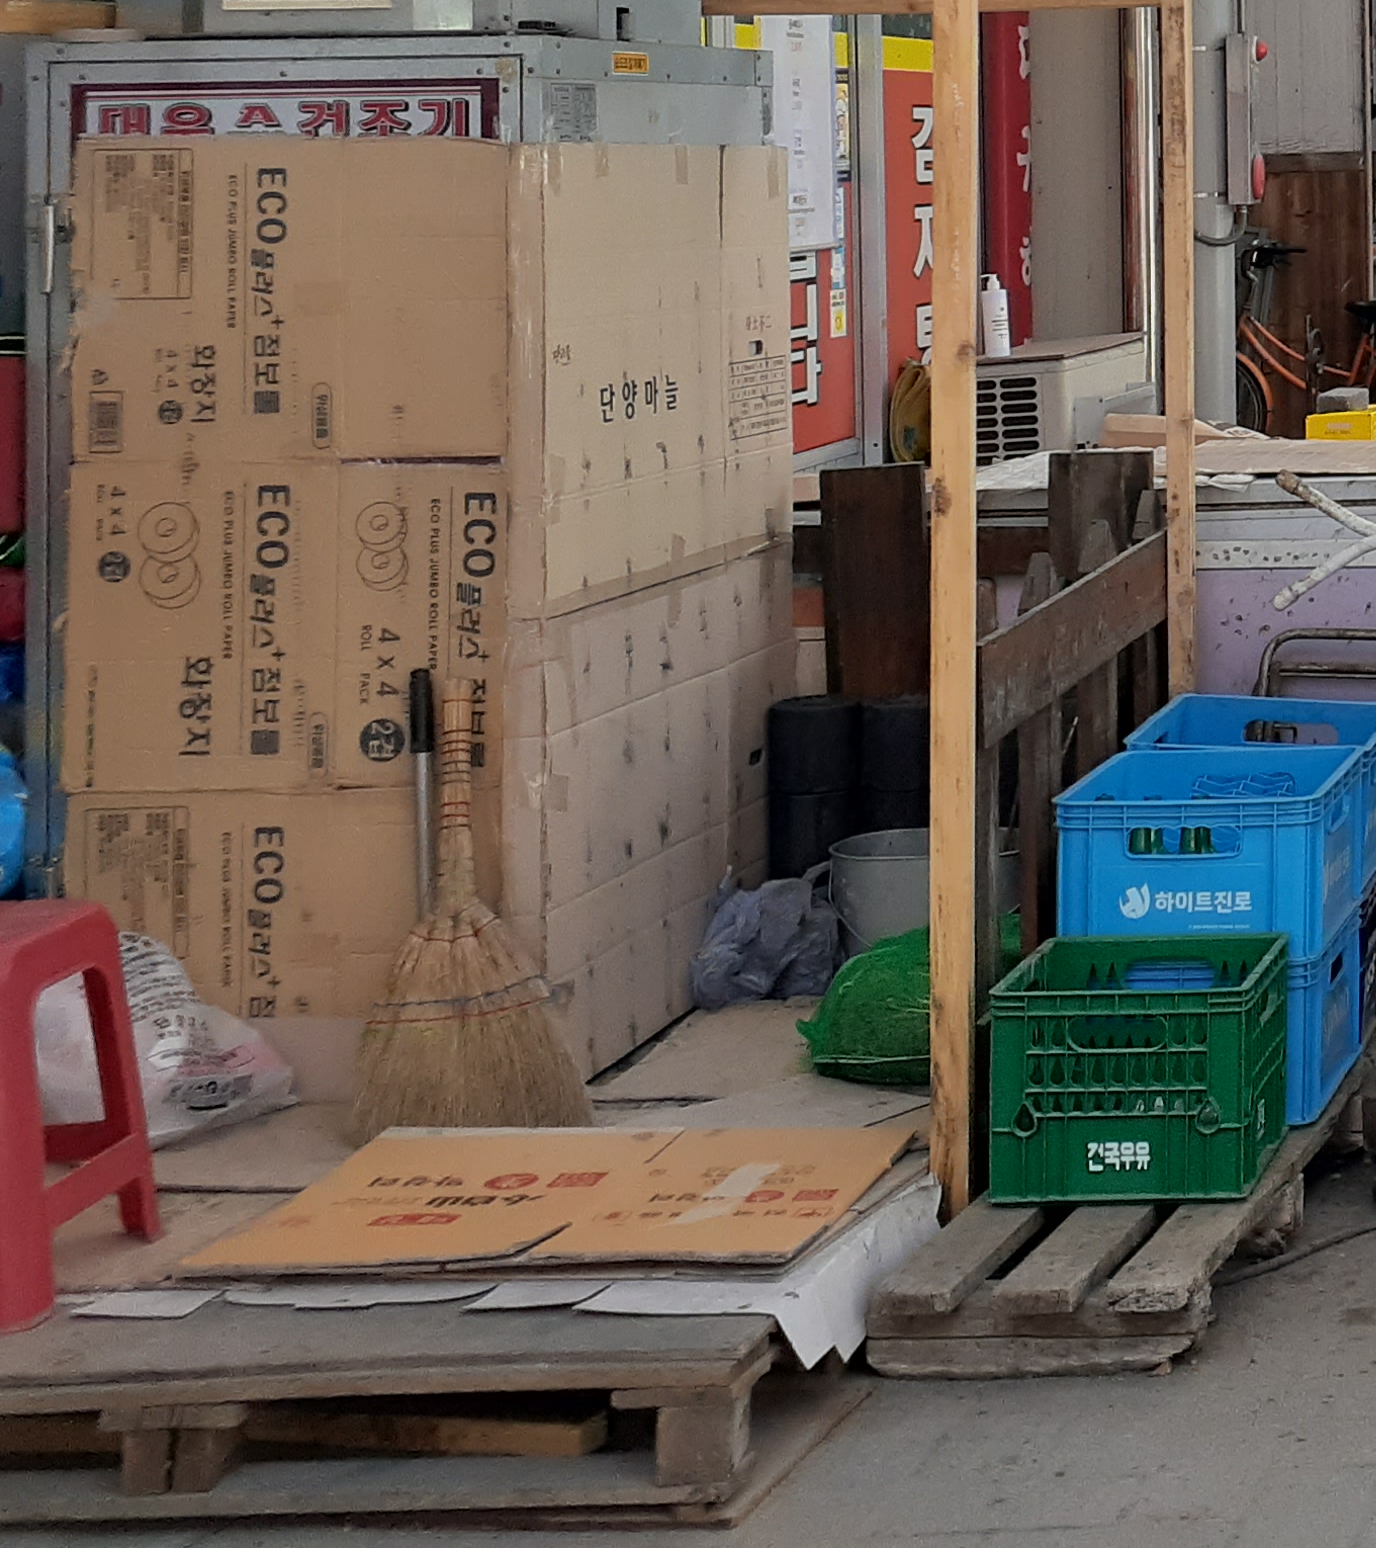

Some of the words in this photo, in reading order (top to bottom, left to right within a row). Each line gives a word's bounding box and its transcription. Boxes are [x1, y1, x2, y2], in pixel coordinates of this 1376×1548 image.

[429, 498, 441, 523] ECO
[429, 527, 441, 554] PLUS
[428, 558, 441, 598] JUMBO
[428, 602, 440, 631] ROLL
[360, 624, 373, 651] ROLL
[428, 634, 439, 671] PAPER
[359, 673, 371, 705] PACK
[178, 656, 214, 758] 화장지
[1154, 889, 1253, 915] 하이트진로
[1086, 1141, 1151, 1172] 건국우유
